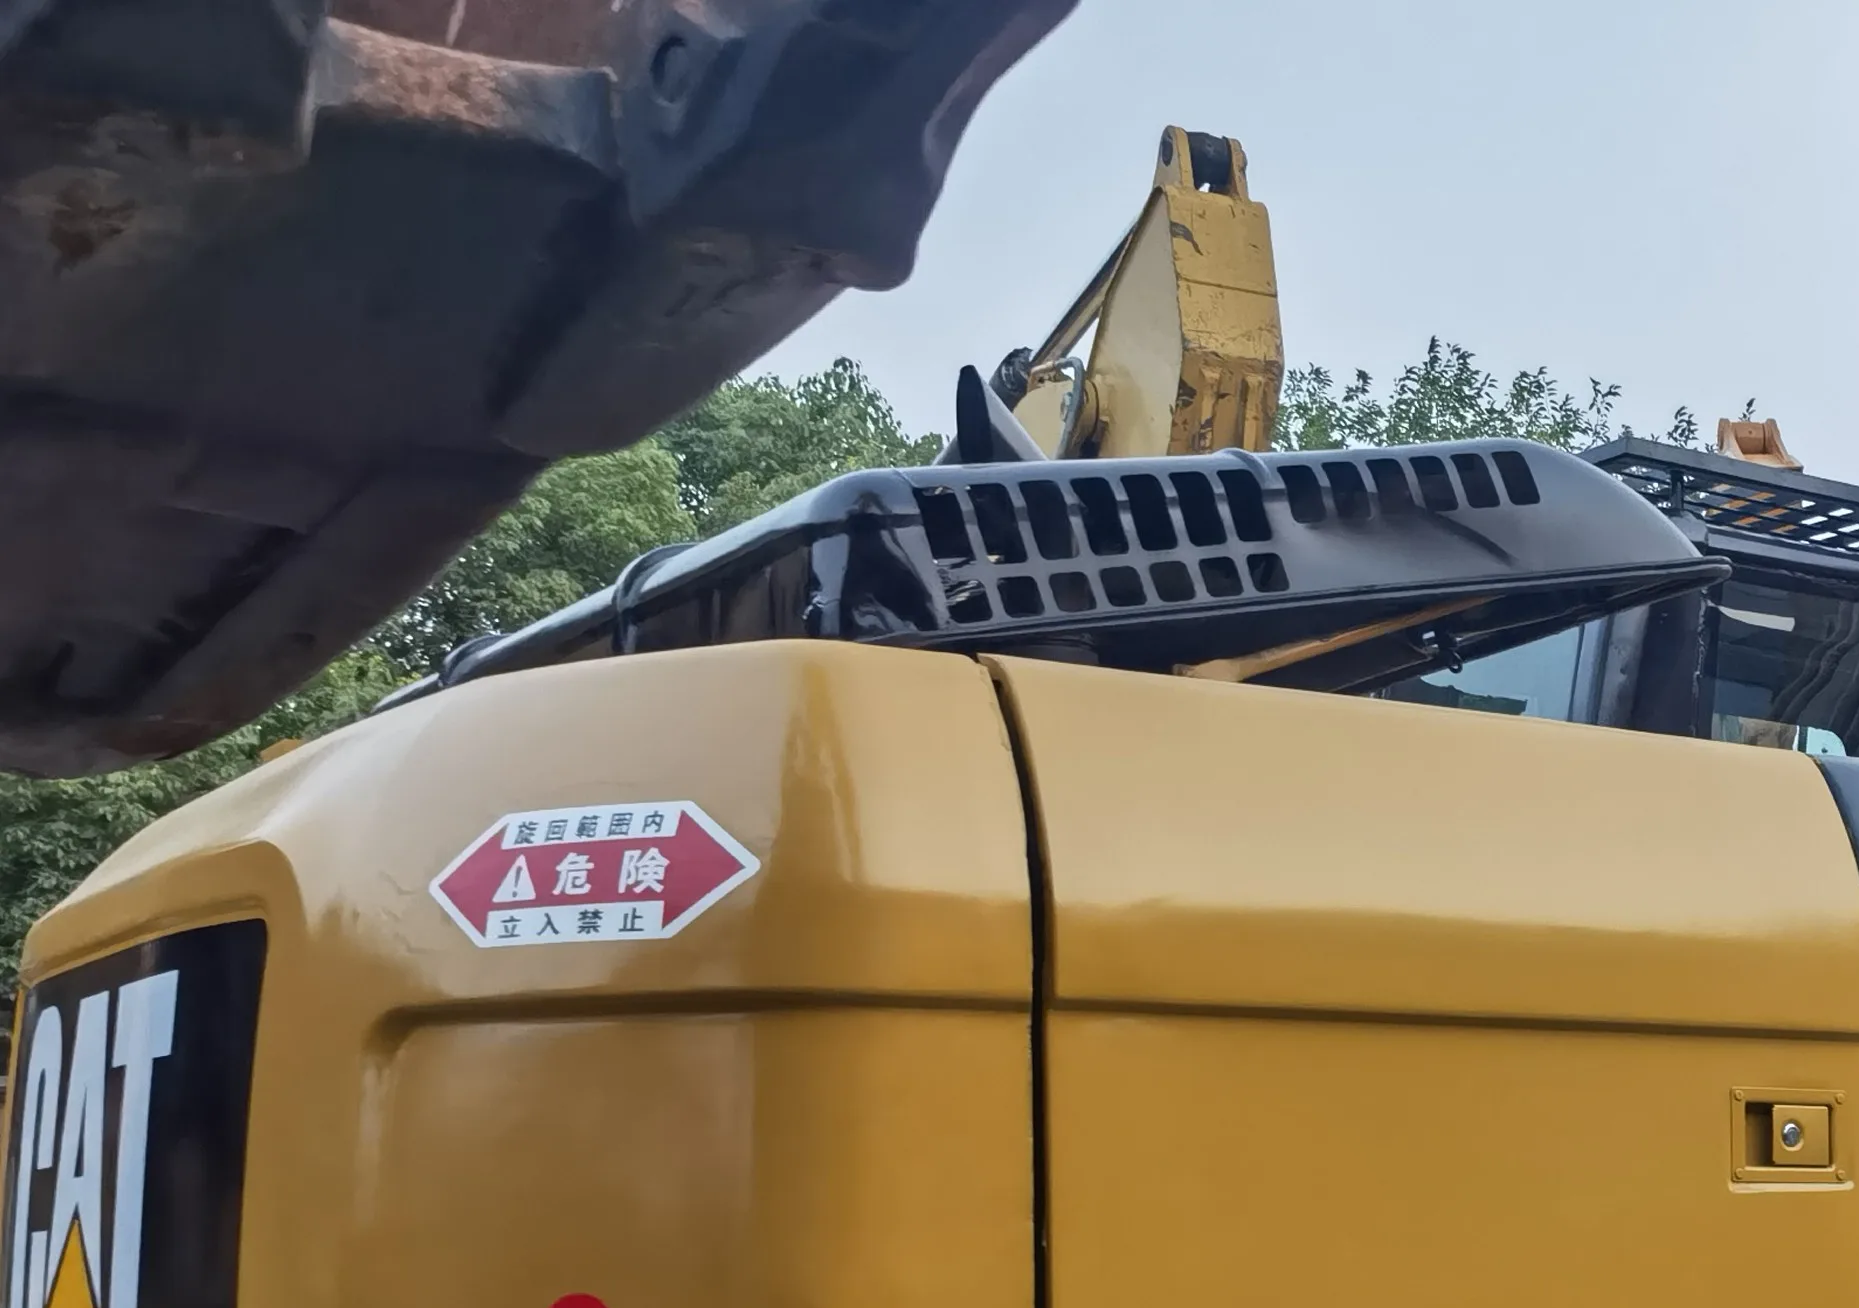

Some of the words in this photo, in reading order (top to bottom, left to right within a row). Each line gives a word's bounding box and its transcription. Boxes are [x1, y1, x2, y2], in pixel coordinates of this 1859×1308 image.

[514, 810, 665, 845] 旋回範囲内
[552, 847, 670, 895] 危険
[498, 908, 645, 939] 立入禁止
